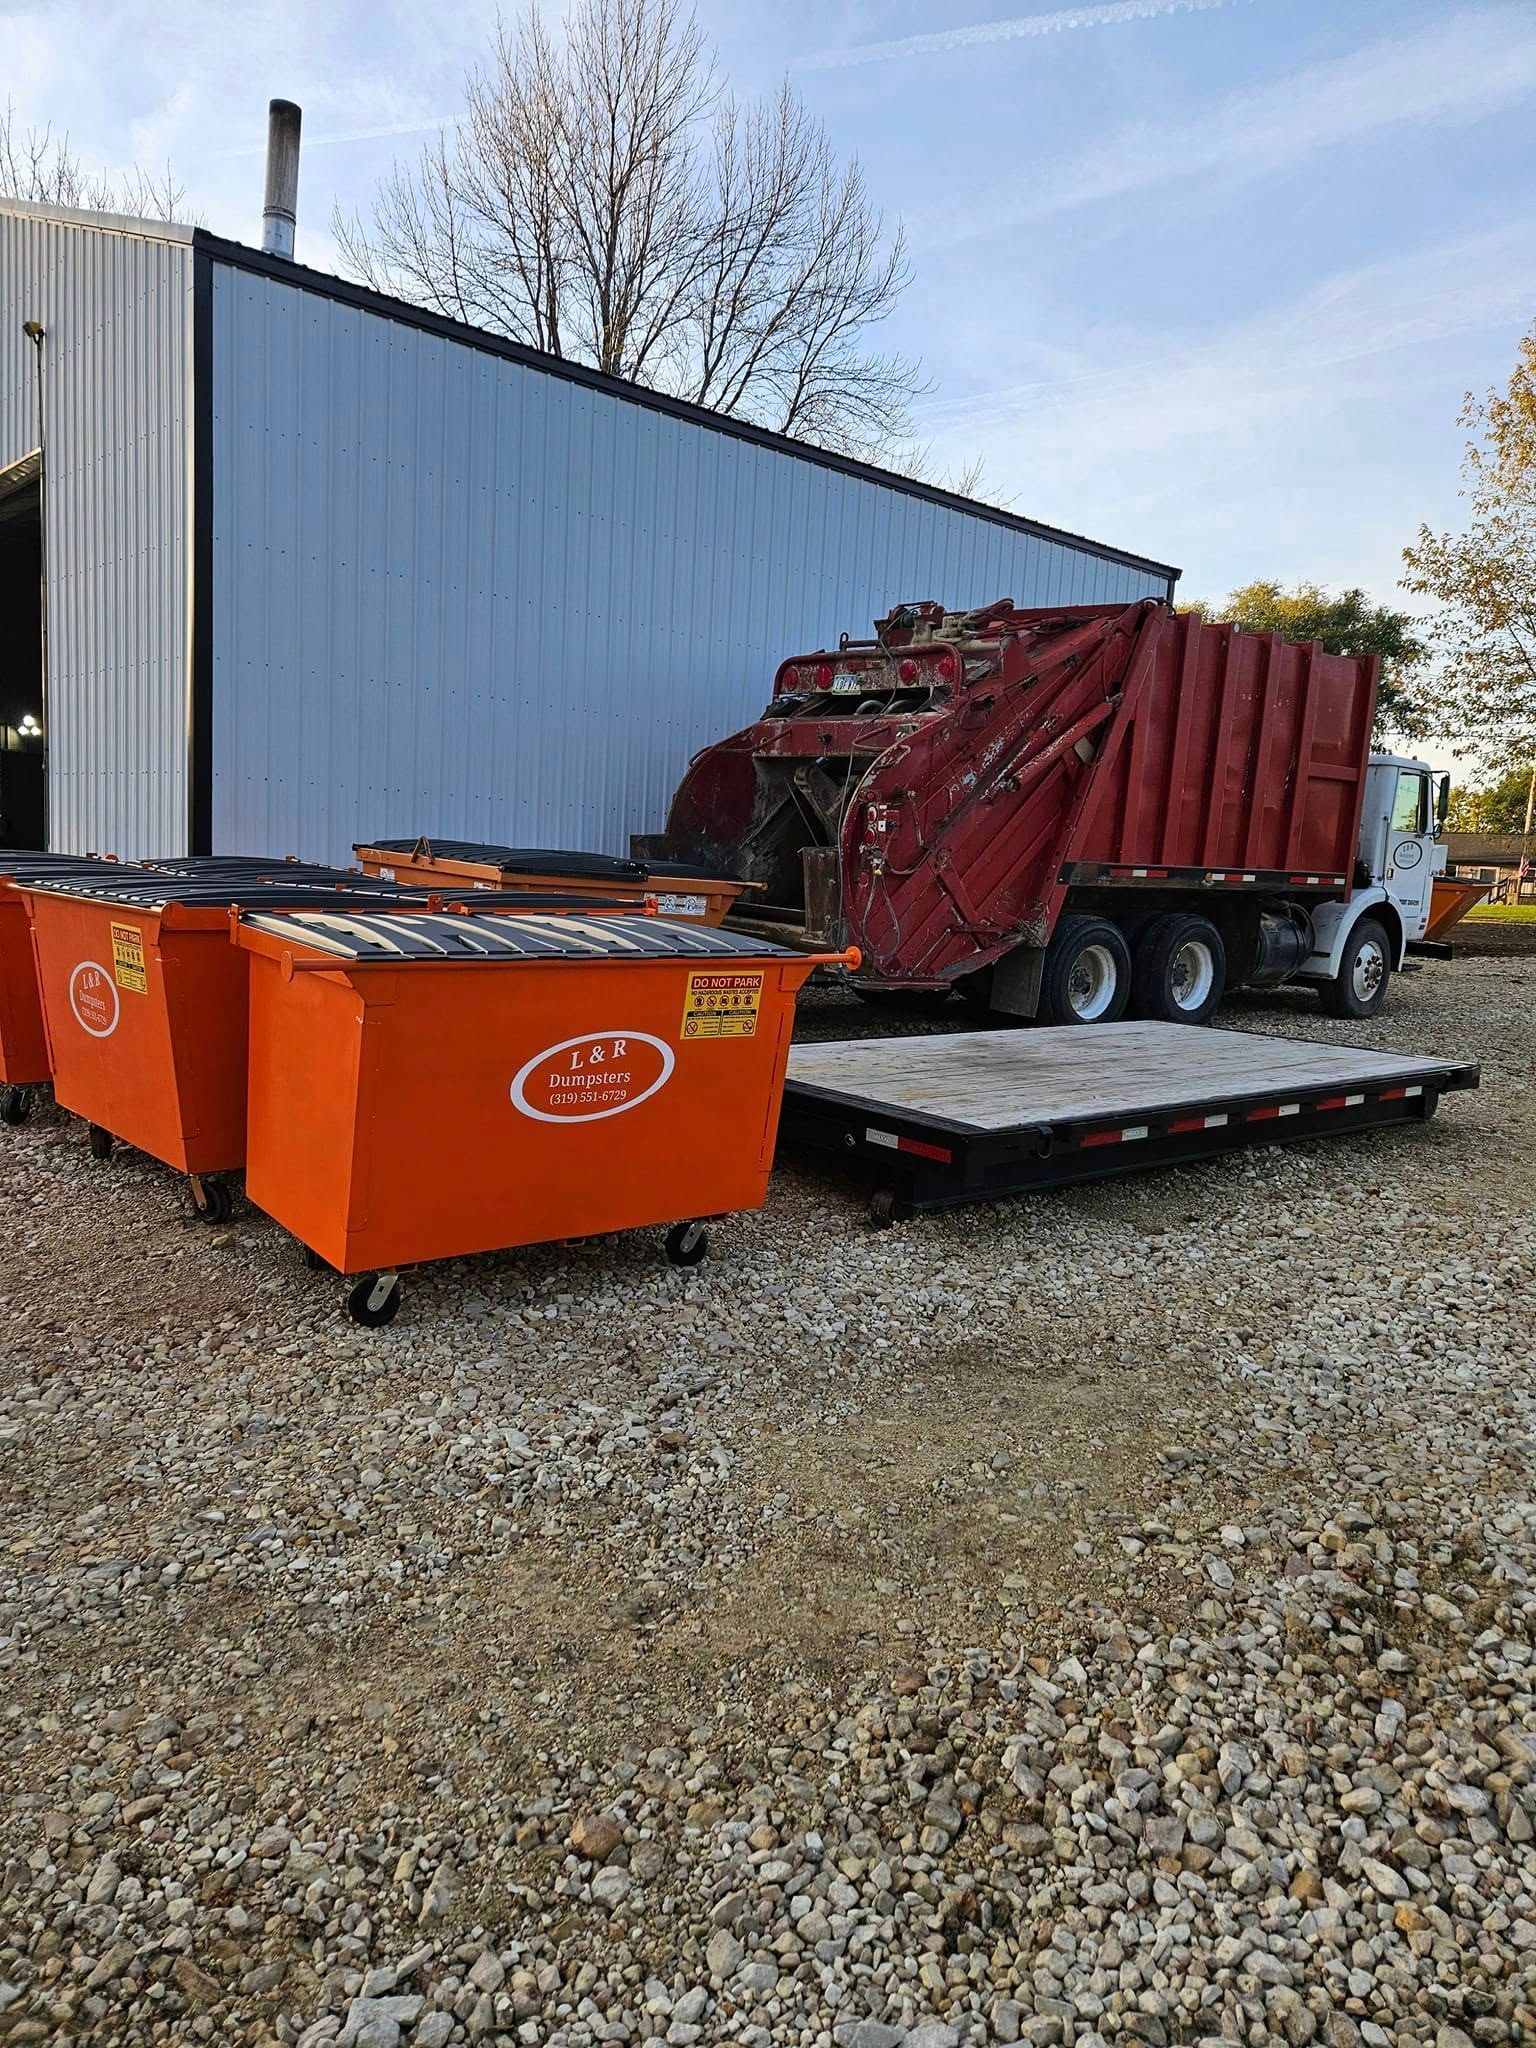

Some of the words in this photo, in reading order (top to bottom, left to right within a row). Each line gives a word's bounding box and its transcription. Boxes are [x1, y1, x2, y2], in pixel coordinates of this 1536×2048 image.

[82, 974, 89, 989] L
[88, 972, 95, 988] &
[94, 970, 101, 987] R
[694, 978, 709, 988] DO
[711, 978, 733, 988] NOT
[734, 977, 760, 987] PARK
[570, 1051, 584, 1071] L
[589, 1045, 606, 1064] &
[612, 1039, 626, 1058] R
[549, 1071, 631, 1089] Dumpsters
[550, 1092, 578, 1105] (319)
[579, 1090, 627, 1103] 551-6729
